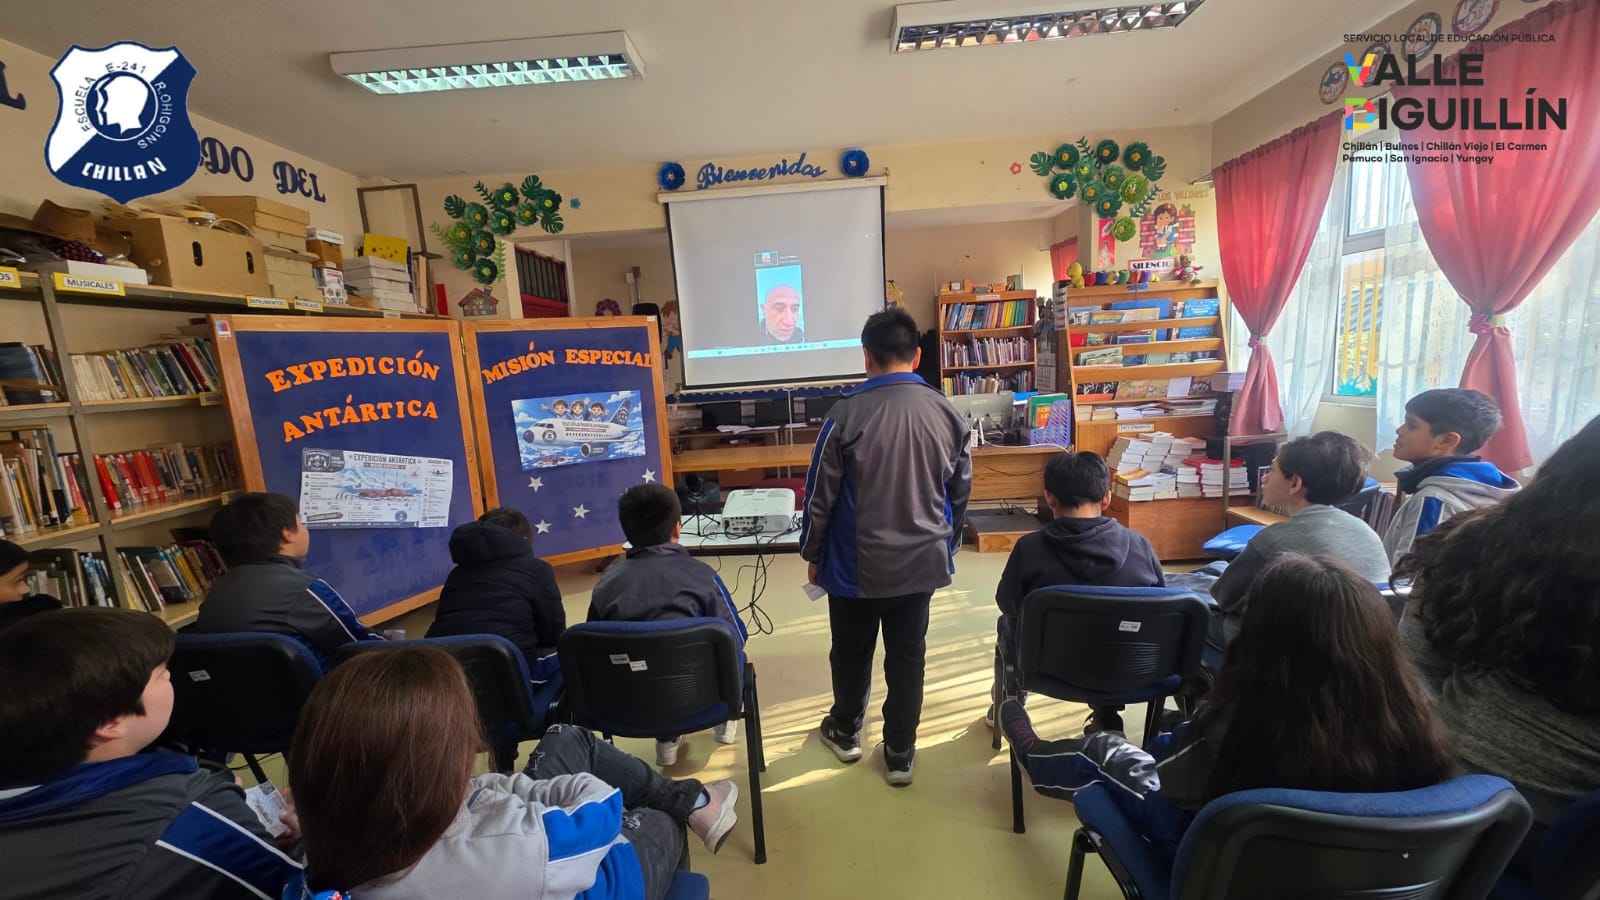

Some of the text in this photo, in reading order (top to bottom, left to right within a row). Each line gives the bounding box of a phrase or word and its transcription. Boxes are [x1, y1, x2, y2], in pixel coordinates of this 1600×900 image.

[272, 161, 327, 203] DEL
[697, 152, 827, 190] Bienvenidos
[66, 278, 115, 290] MUSICALES
[1132, 260, 1174, 270] SILENCIO
[264, 349, 440, 393] EXPEDICIÓN
[481, 340, 654, 385] MISIÓN ESPECIAL
[282, 393, 439, 443] ANTÁRTICA
[353, 453, 387, 463] EXPEDICIÓN
[388, 455, 417, 465] ANTÁRTICA
